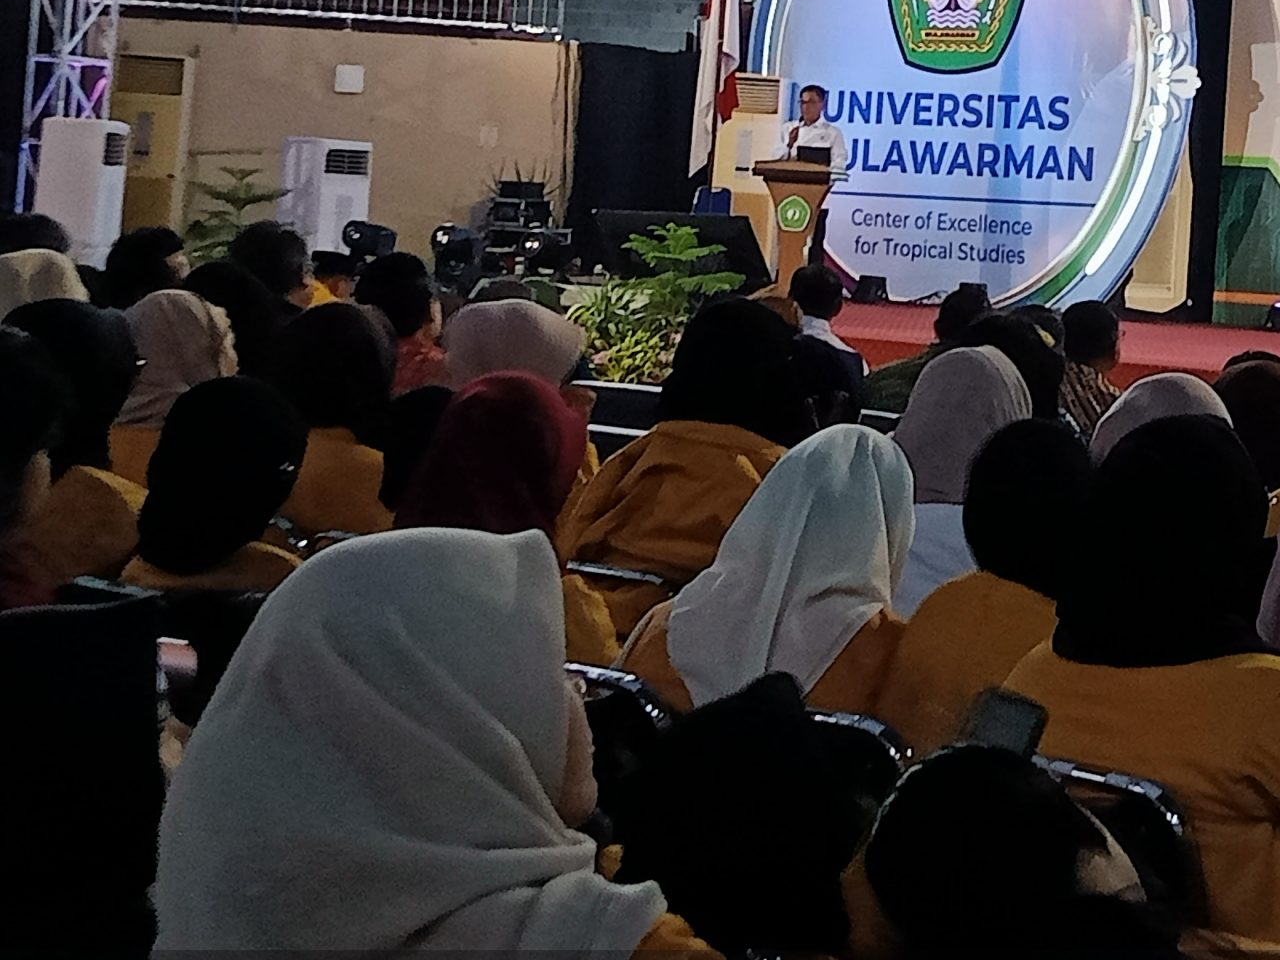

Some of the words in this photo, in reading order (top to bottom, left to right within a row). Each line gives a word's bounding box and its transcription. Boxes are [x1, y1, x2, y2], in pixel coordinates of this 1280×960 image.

[823, 90, 1069, 131] UNIVERSITAS
[845, 138, 1095, 182] ULAWARMAN
[851, 208, 909, 230] Center
[914, 211, 932, 230] of
[937, 213, 1032, 236] Excellence
[854, 235, 878, 255] for
[882, 238, 952, 262] Tropical
[958, 242, 1025, 265] Studies
